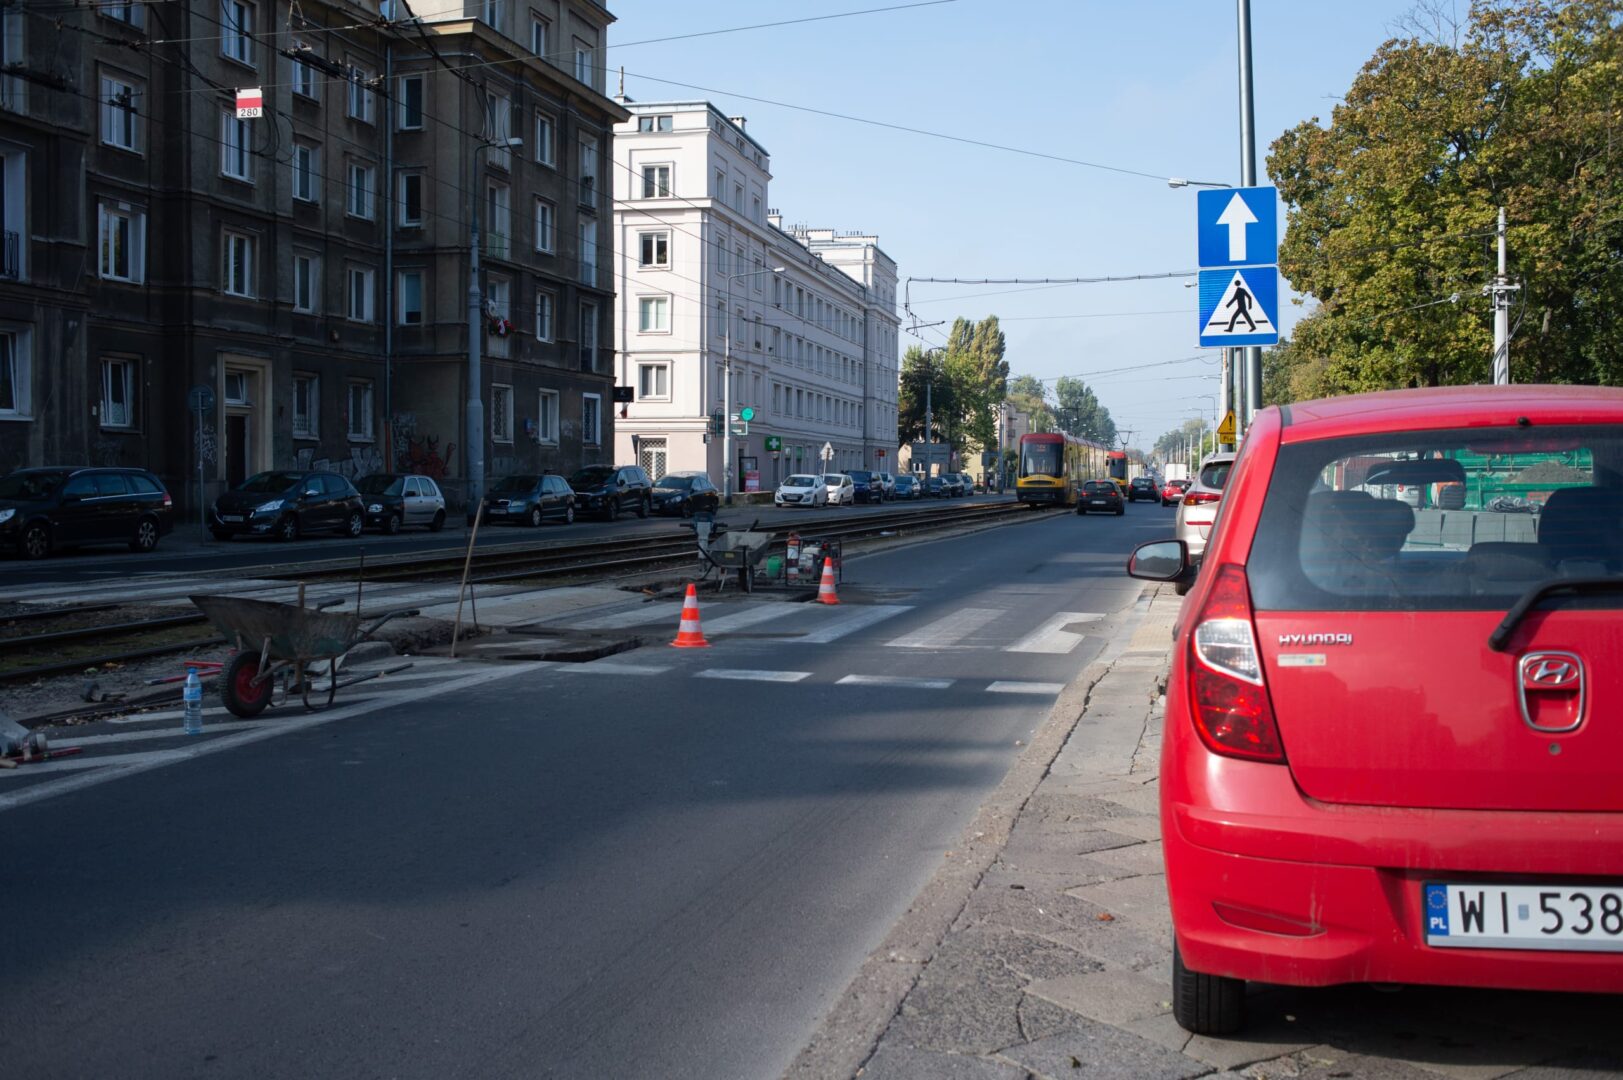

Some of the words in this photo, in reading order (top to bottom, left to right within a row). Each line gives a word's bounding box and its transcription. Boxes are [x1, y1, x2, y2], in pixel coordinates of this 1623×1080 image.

[240, 108, 258, 117] 280
[1278, 632, 1353, 646] HYUNDAI
[1458, 891, 1509, 934] WI
[1539, 892, 1623, 936] 538
[1430, 917, 1447, 930] PL
